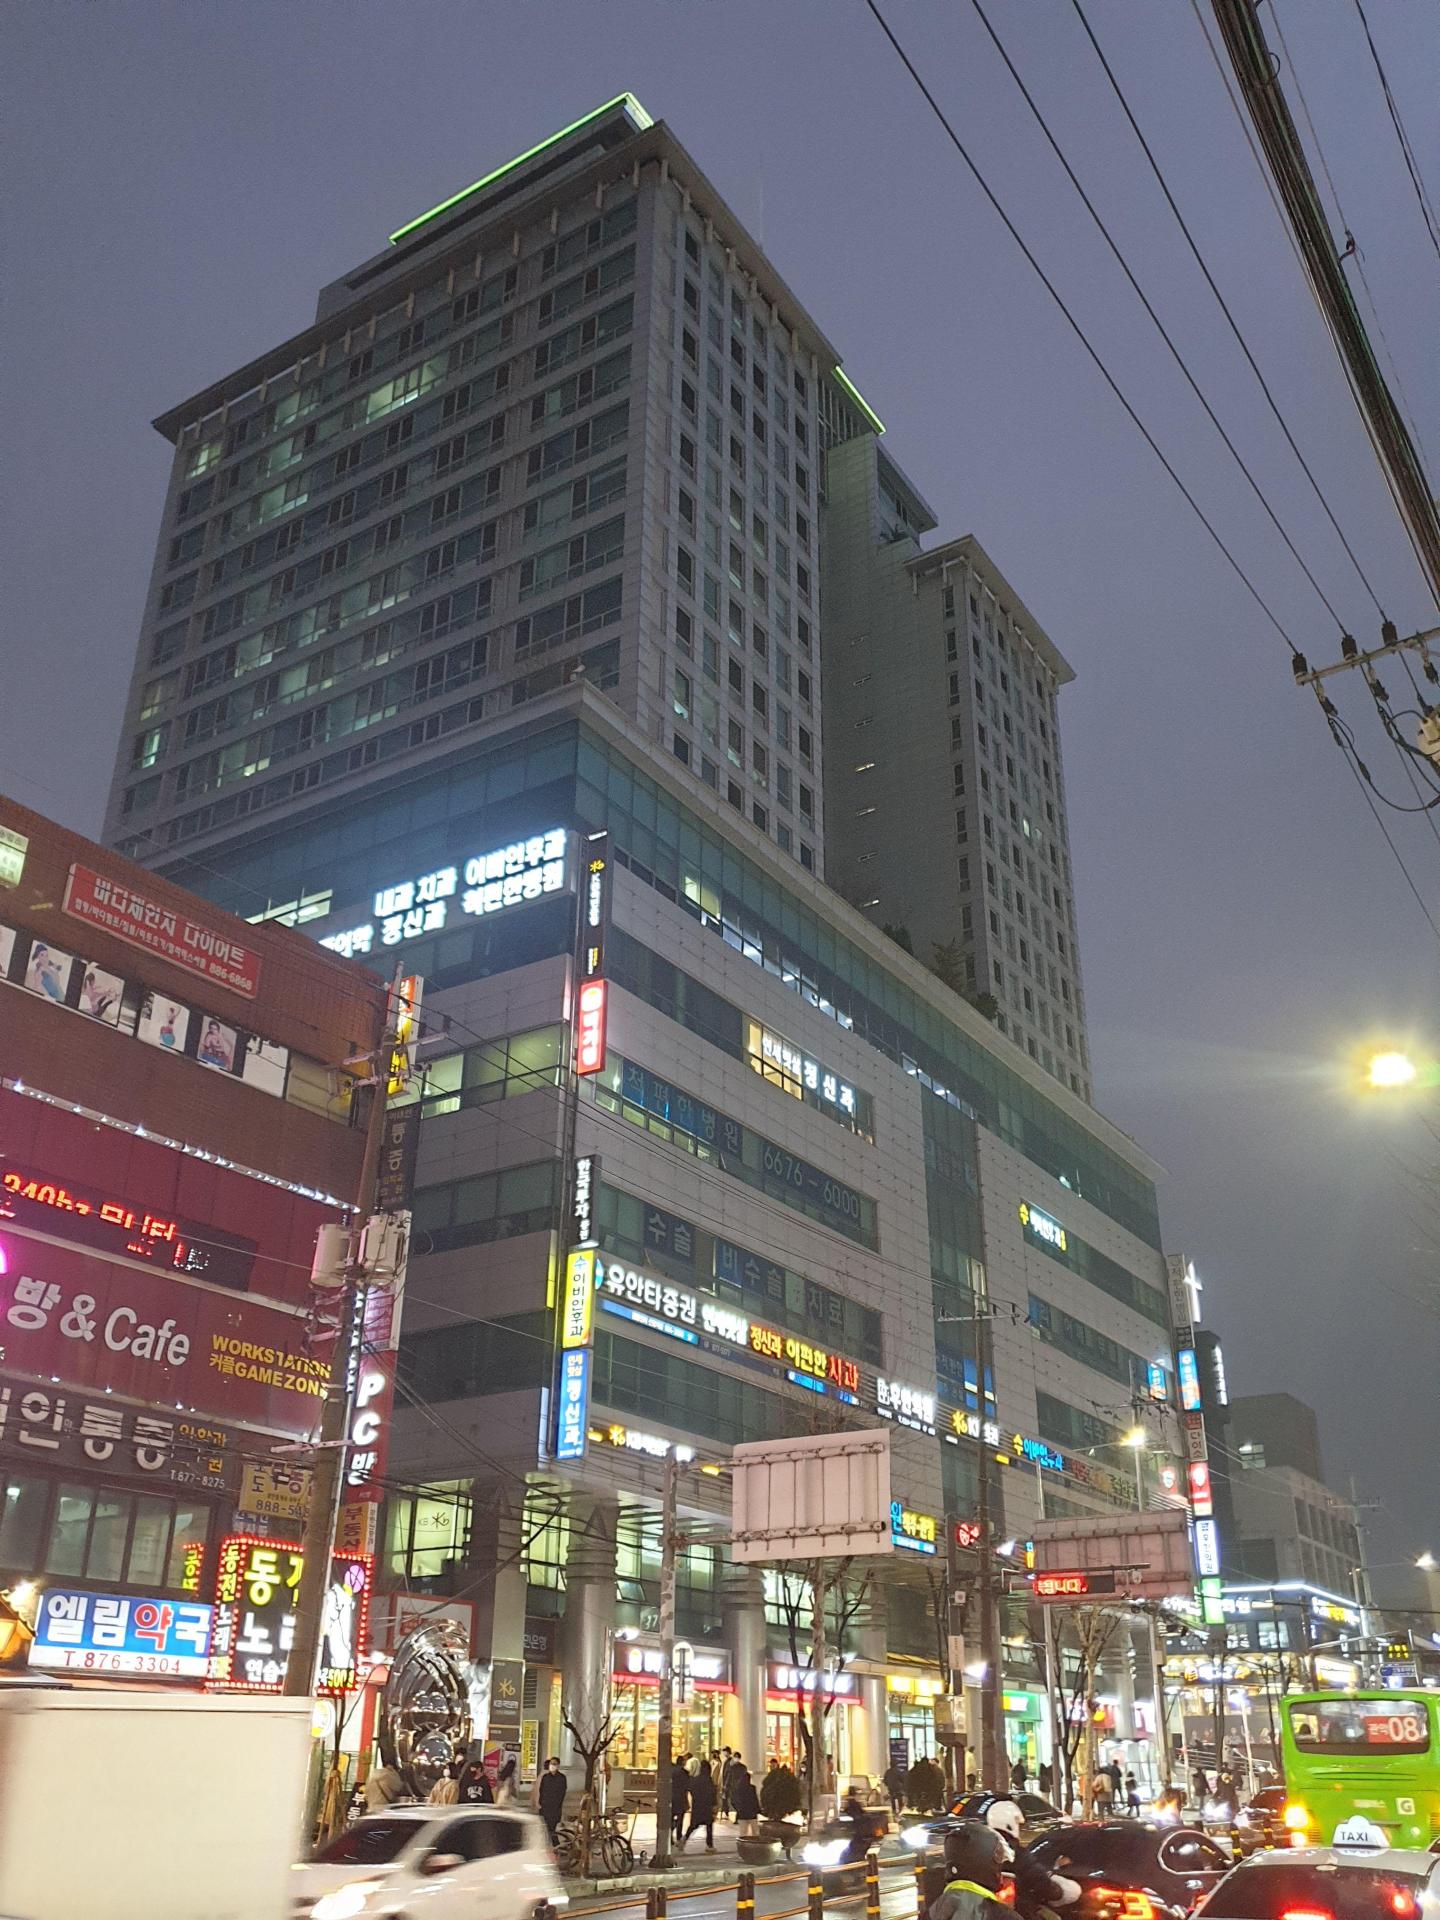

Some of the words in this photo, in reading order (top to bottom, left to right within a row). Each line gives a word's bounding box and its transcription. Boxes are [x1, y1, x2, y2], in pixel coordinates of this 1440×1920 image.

[374, 881, 415, 917] 내과
[382, 900, 446, 945] 정신과
[183, 921, 246, 970] 다이어트
[804, 1060, 855, 1113] 정신과
[649, 1212, 692, 1257] 수술
[606, 1264, 697, 1324] 유안타증권
[7, 1276, 62, 1330] 방
[60, 1294, 97, 1342] &
[104, 1306, 190, 1366] Cafe
[750, 1325, 783, 1359] 정신과
[212, 1334, 331, 1379] WORKSTATION
[786, 1338, 827, 1377] 이편한
[0, 1387, 174, 1470] 인통증
[219, 1545, 240, 1601] 동전
[47, 1593, 210, 1654] 엘림약국
[64, 1650, 181, 1674] T.876-3304
[1387, 1716, 1420, 1741] 08
[1341, 1831, 1369, 1842] TAXI
